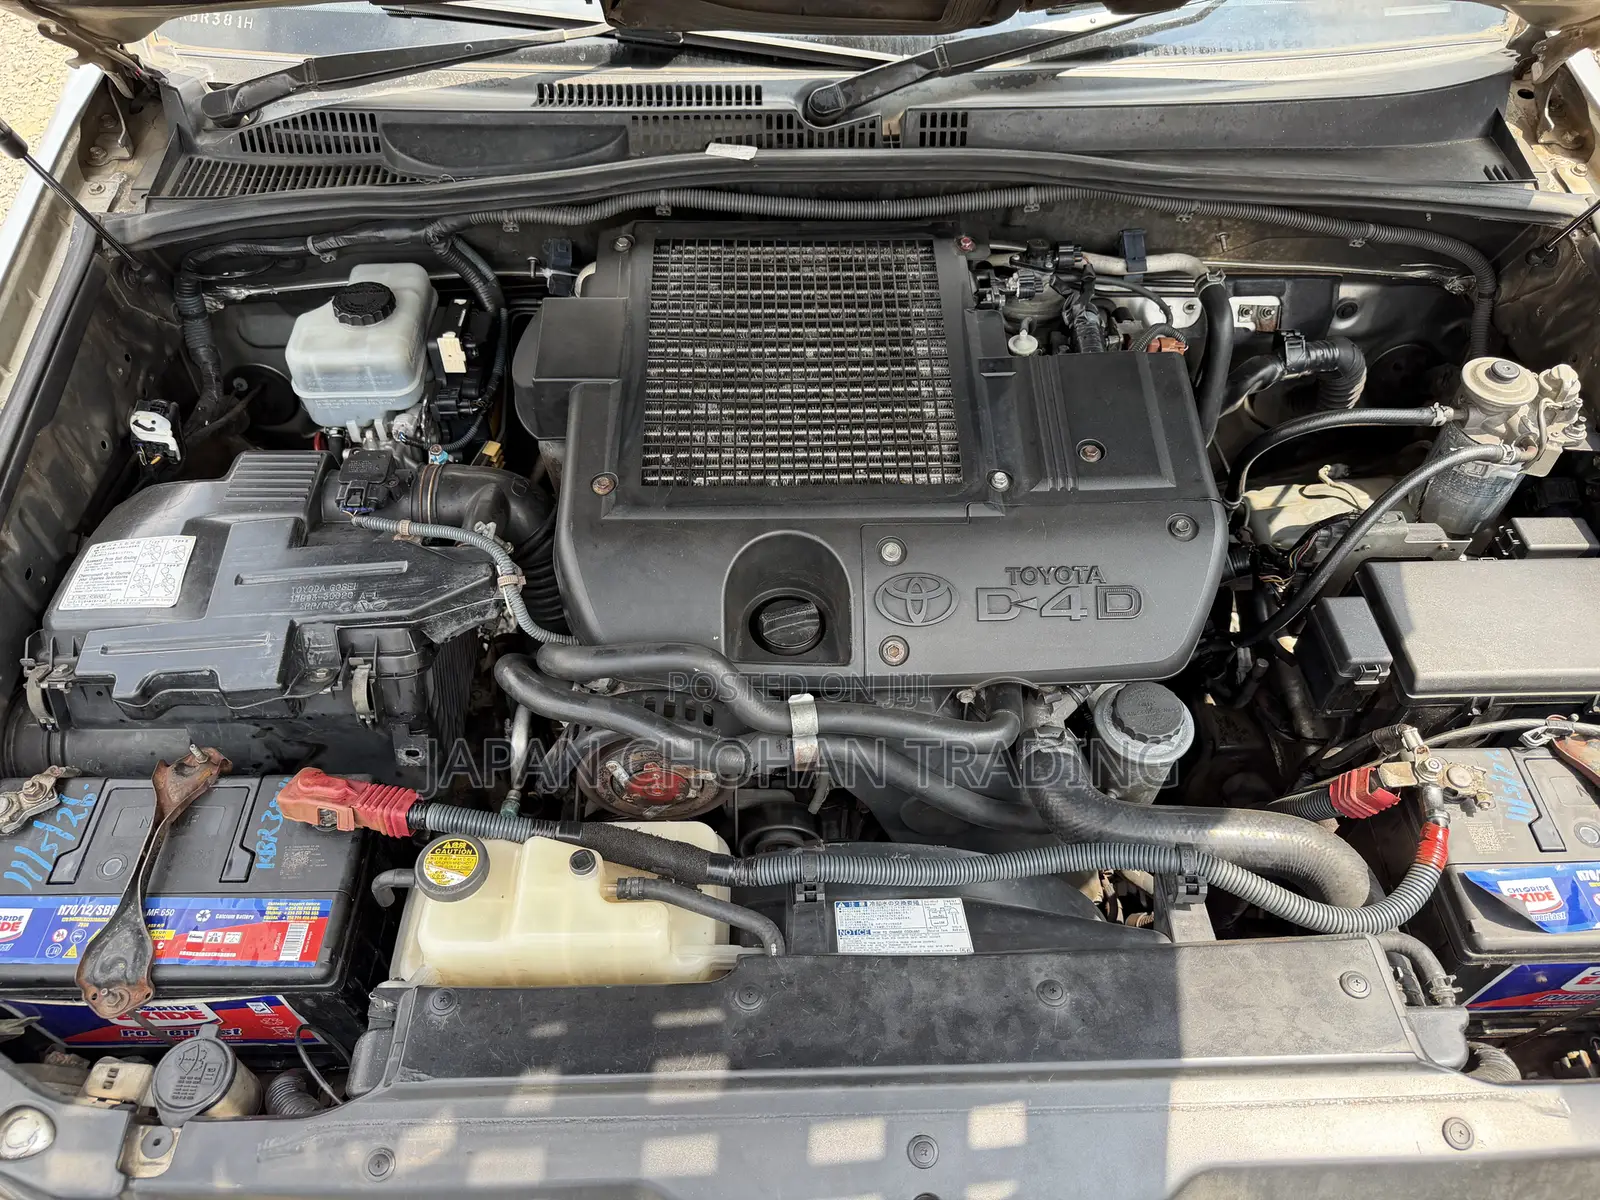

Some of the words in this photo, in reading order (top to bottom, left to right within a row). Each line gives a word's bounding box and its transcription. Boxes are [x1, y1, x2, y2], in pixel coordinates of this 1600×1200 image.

[1005, 565, 1107, 586] TOYOTA
[291, 585, 326, 594] TOYODA
[329, 583, 357, 592] GOSEI
[976, 584, 1143, 621] D-4D
[435, 848, 473, 856] CAUTION
[1507, 885, 1551, 894] CHLORIDE
[147, 908, 159, 916] MF
